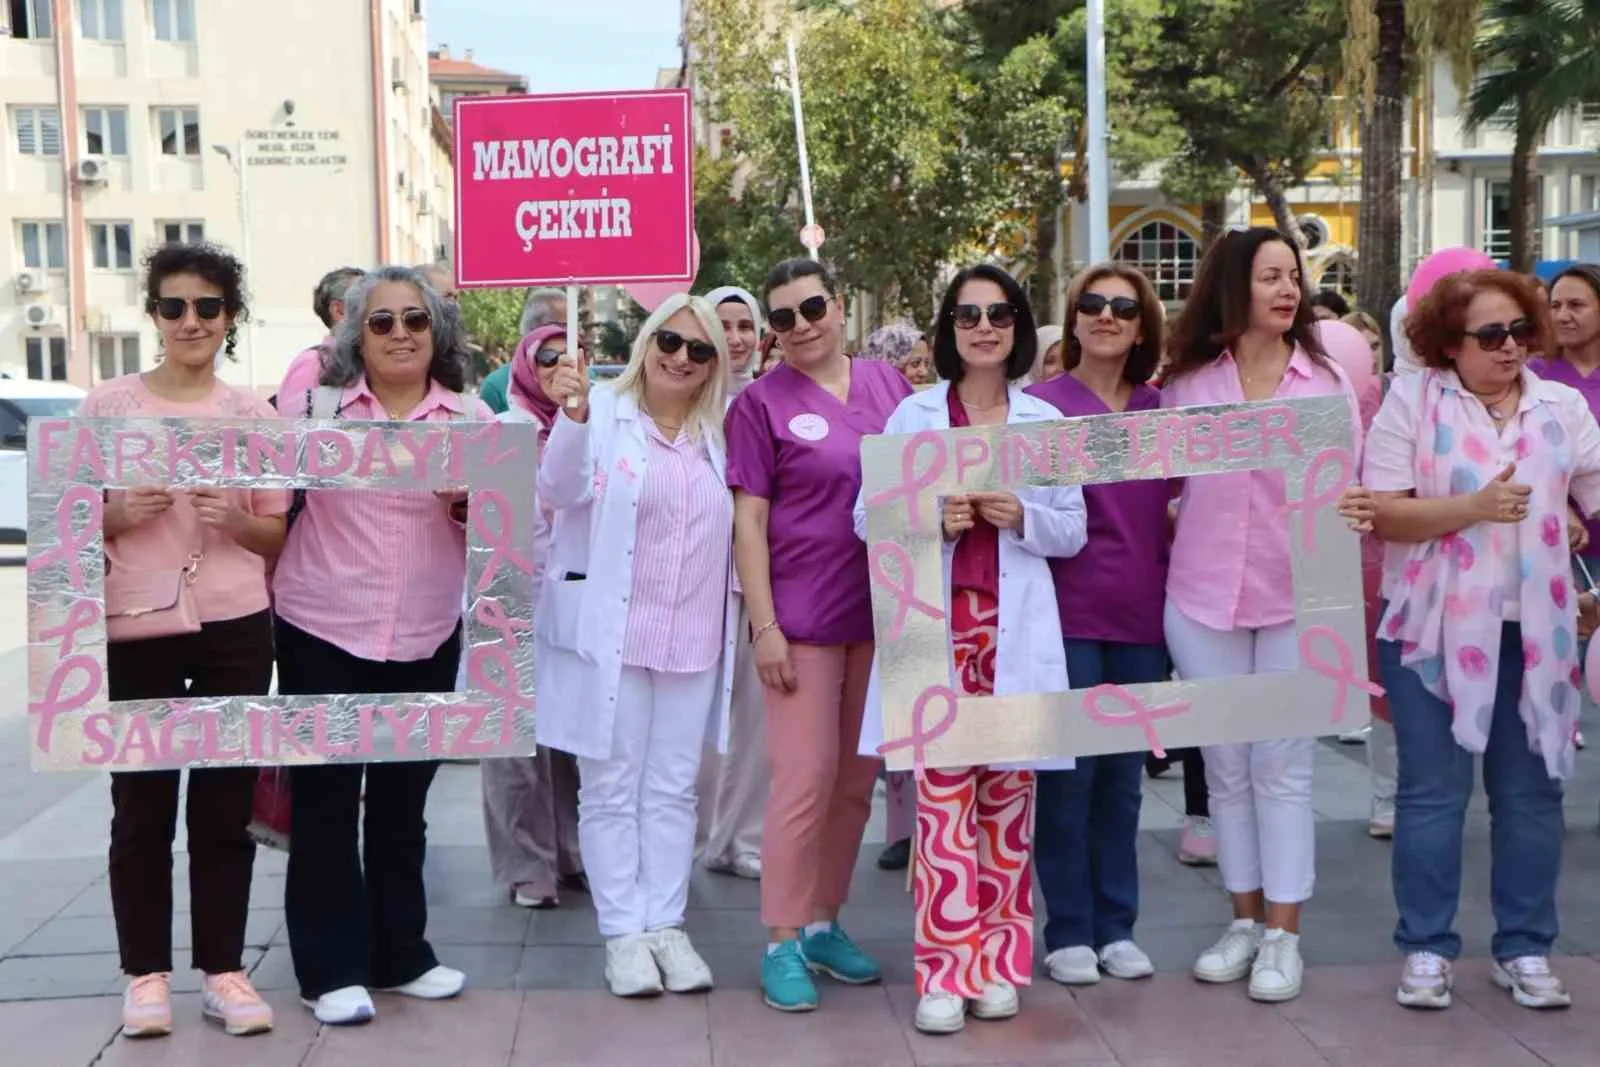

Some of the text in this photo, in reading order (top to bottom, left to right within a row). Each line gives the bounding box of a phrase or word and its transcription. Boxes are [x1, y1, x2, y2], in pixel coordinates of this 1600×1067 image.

[472, 123, 674, 180] MAMOGRAFİ
[515, 187, 633, 253] ÇEKTİR
[81, 700, 494, 764] SAĞLIKLIYIZ
